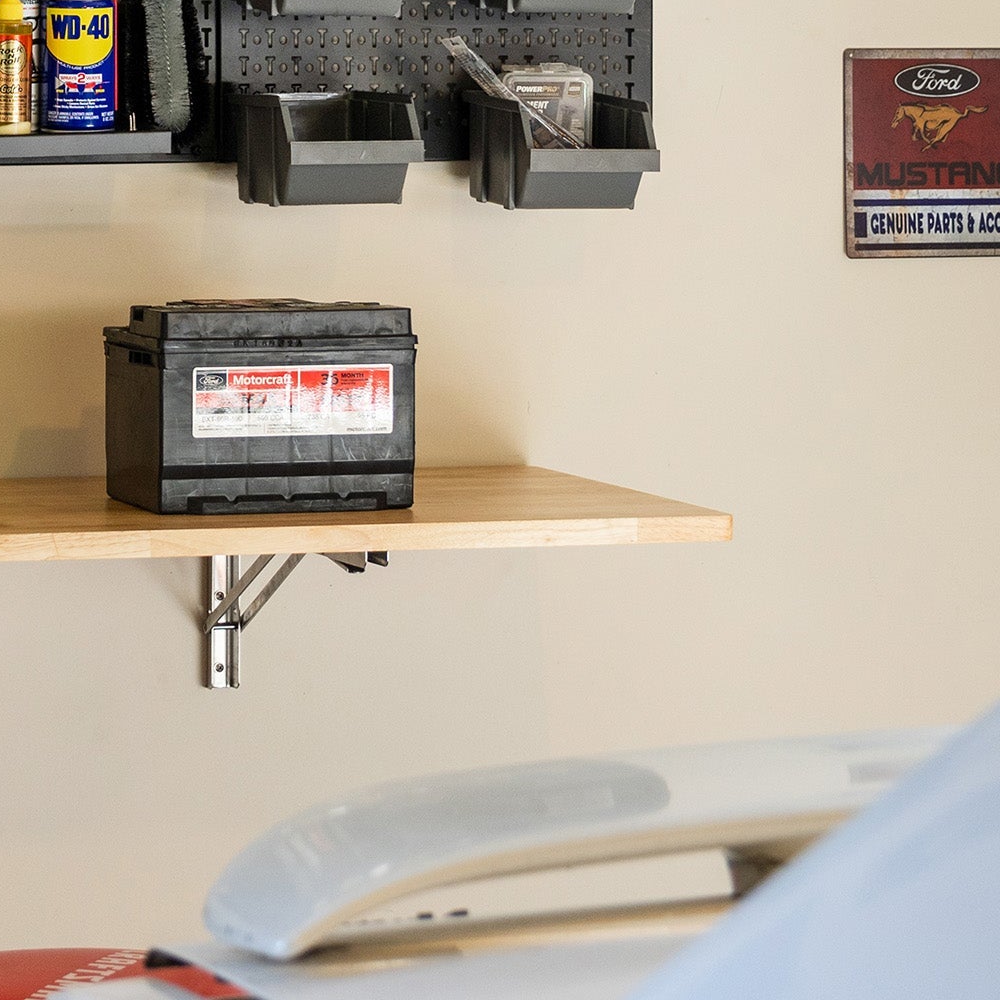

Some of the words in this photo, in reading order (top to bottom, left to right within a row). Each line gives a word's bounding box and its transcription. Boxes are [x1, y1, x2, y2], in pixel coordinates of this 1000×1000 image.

[51, 14, 109, 40] WD-40
[77, 73, 85, 83] 2
[912, 68, 962, 91] Ford
[857, 161, 1000, 187] MUSTAN
[870, 213, 924, 235] GENUINE
[927, 212, 963, 234] PARTS
[967, 212, 975, 234] &
[233, 374, 292, 386] Motorcraft
[321, 373, 339, 386] 36
